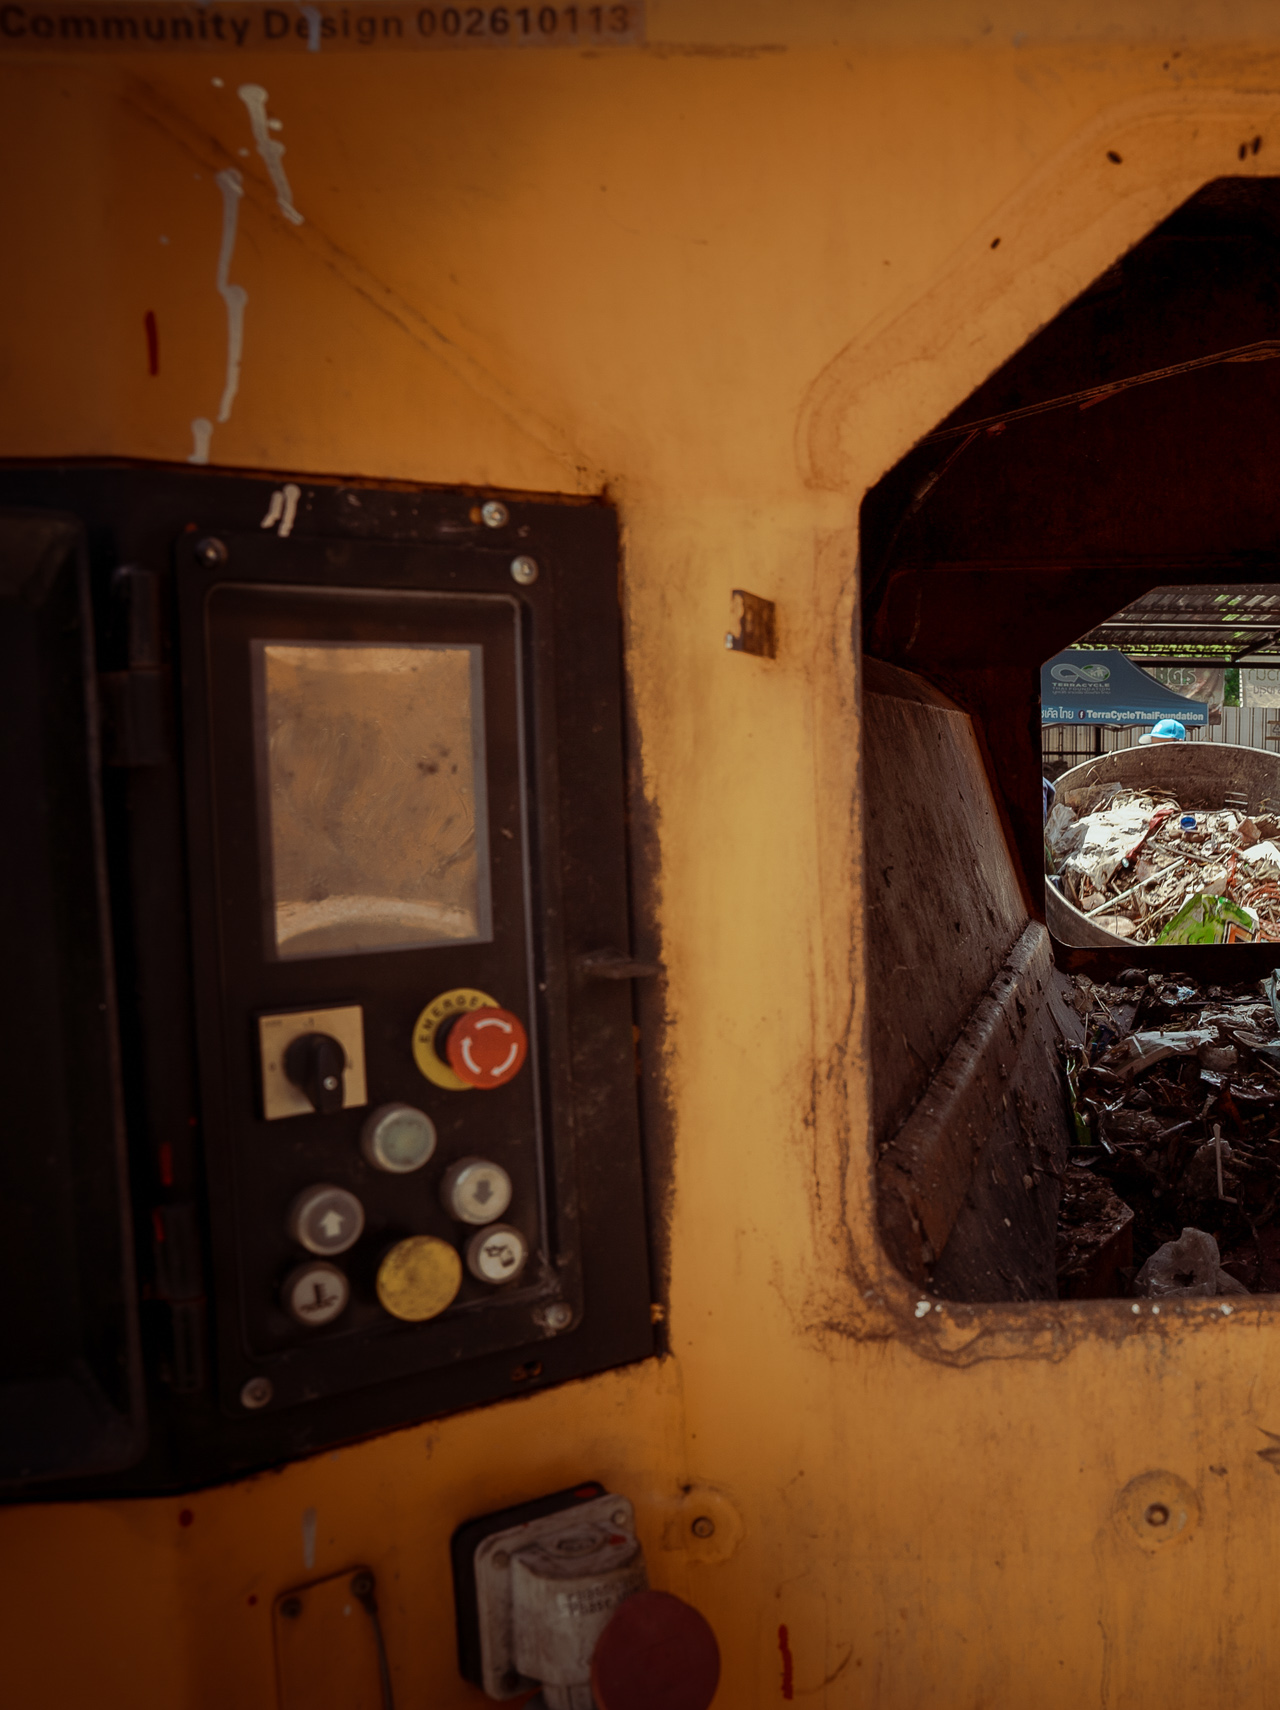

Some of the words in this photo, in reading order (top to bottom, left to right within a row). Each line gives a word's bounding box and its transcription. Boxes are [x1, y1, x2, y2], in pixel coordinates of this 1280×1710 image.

[0, 4, 250, 46] Community
[264, 9, 403, 44] Design
[418, 4, 630, 38] 002610113
[1087, 709, 1204, 722] TerraCycleThaiFoundation
